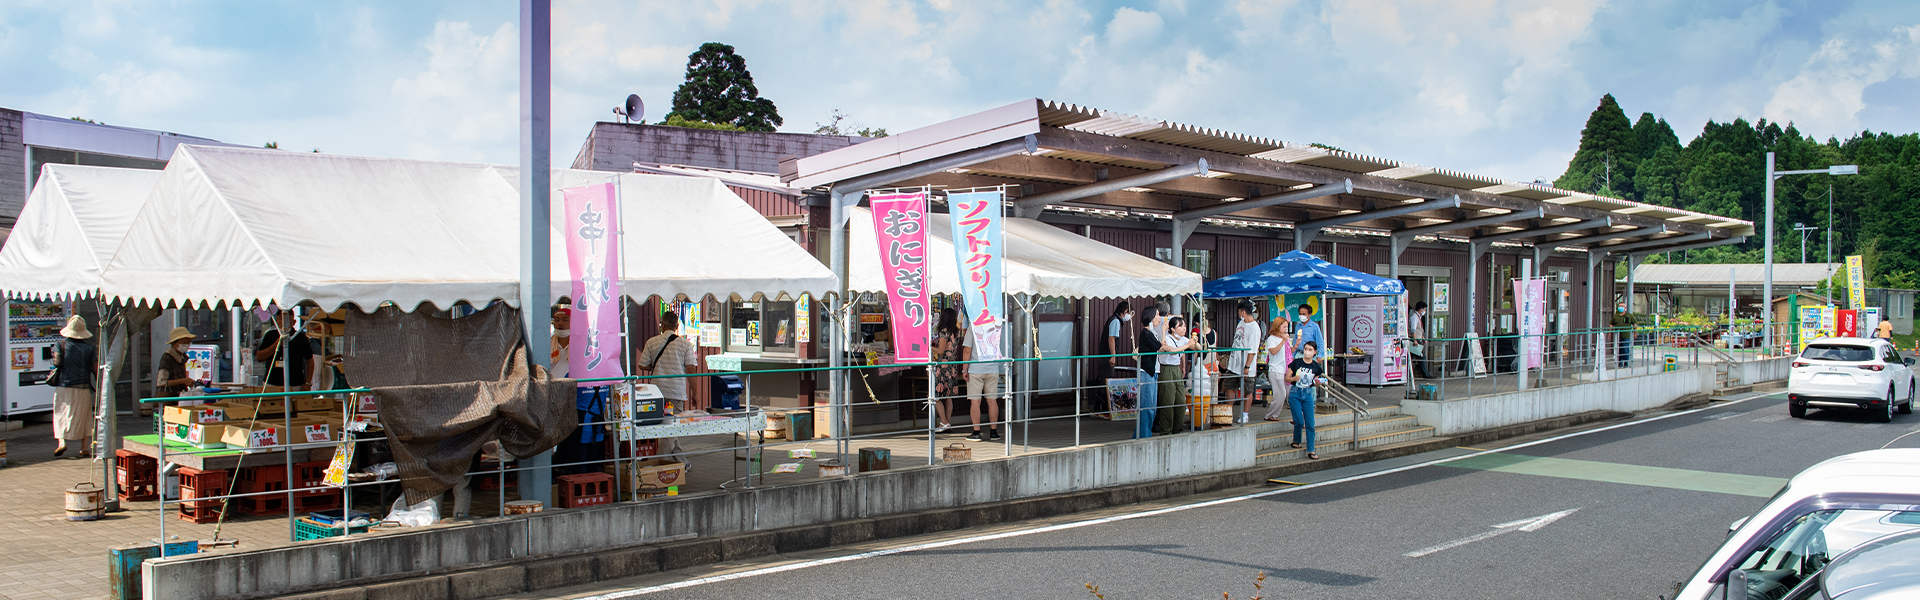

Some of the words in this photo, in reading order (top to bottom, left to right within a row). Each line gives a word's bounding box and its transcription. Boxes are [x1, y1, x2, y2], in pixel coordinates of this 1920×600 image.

[883, 210, 926, 327] おにぎり
[957, 199, 995, 326] ソフトクリーム
